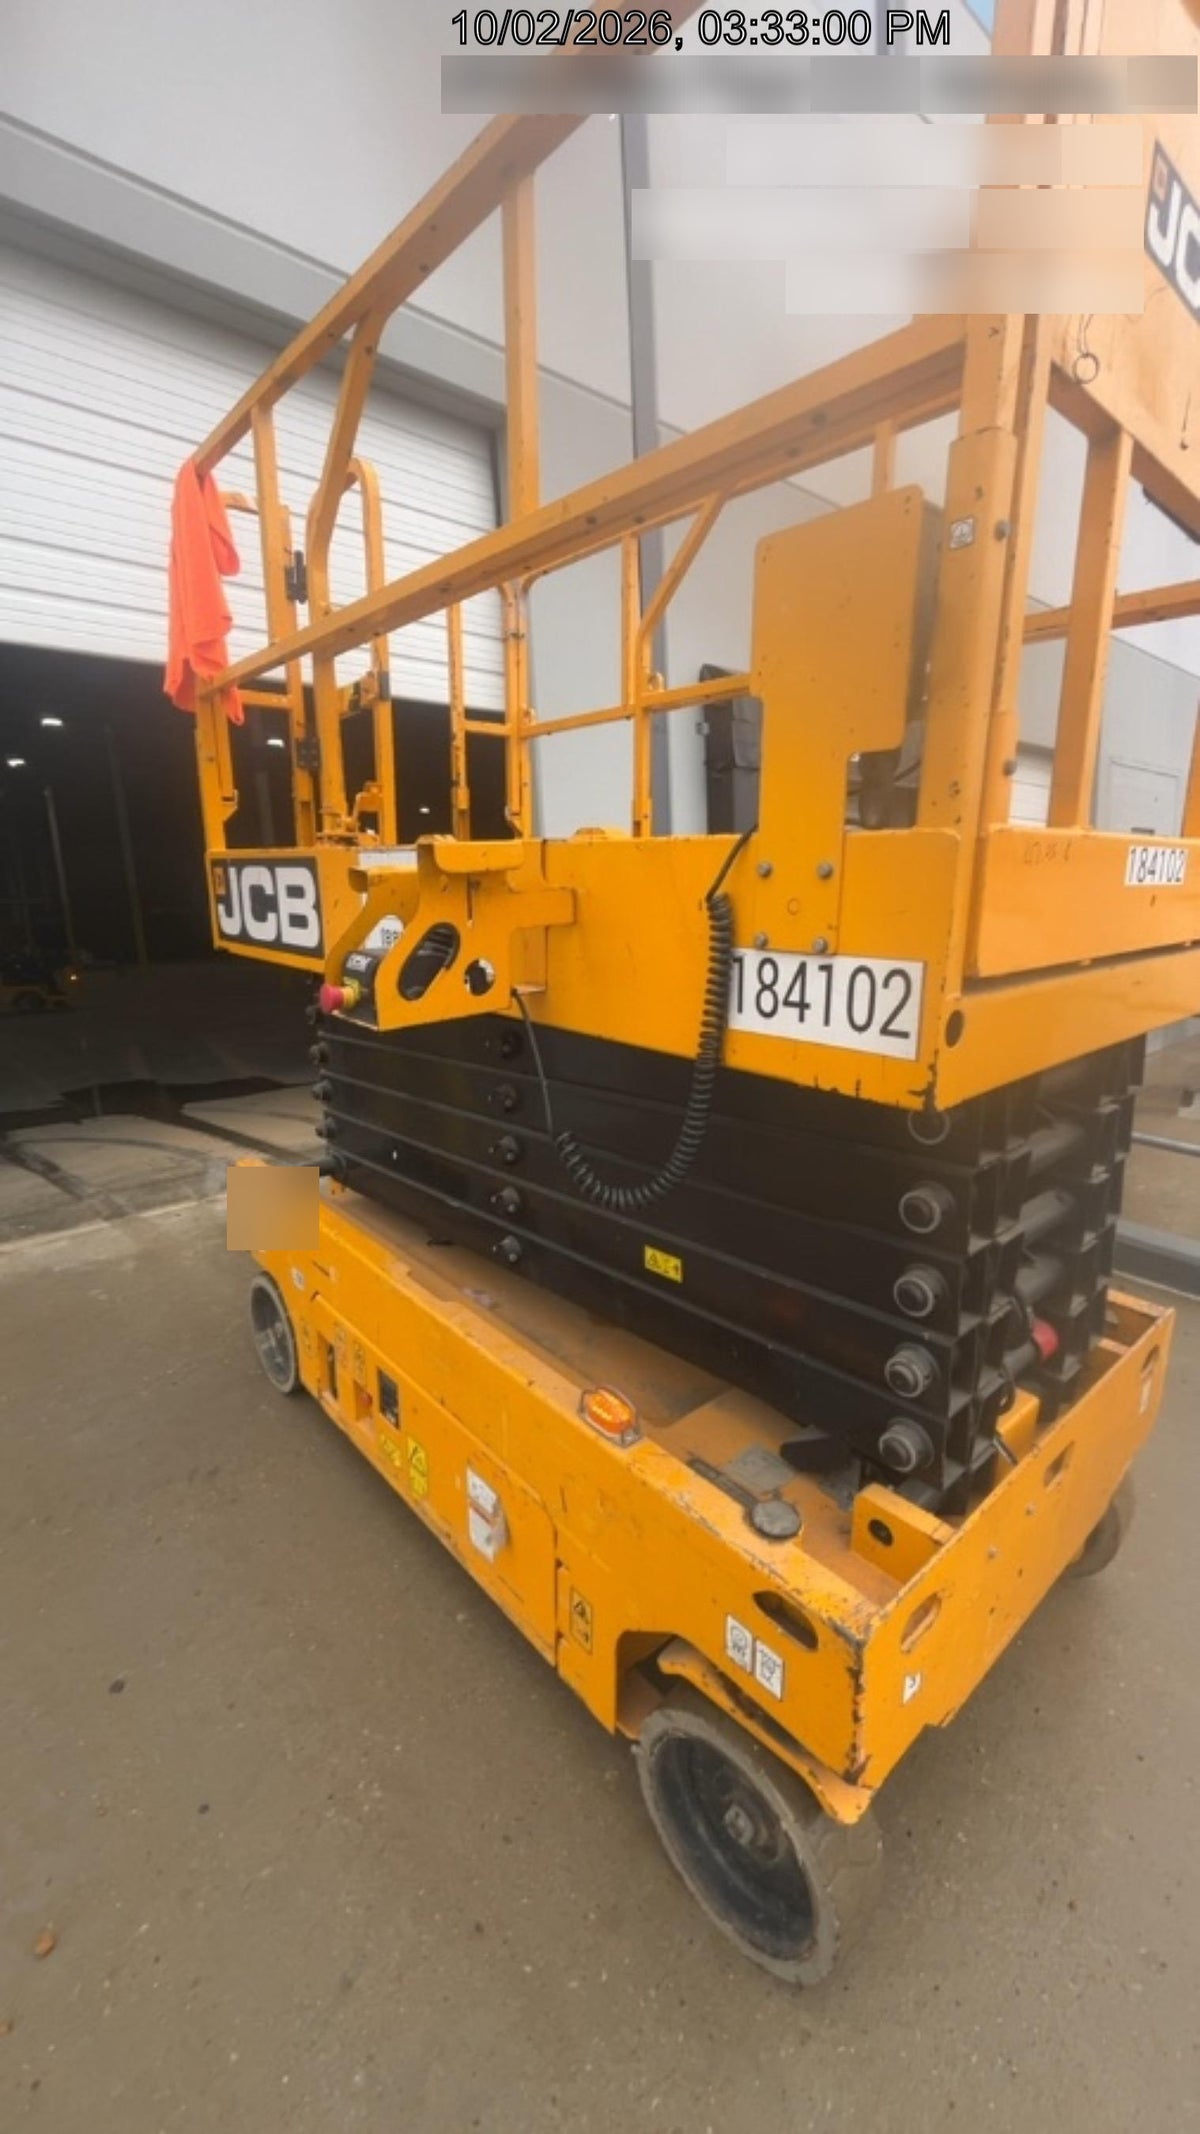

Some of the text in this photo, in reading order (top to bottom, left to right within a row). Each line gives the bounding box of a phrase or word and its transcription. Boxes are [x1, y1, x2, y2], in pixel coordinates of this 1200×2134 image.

[218, 865, 320, 948] JCB
[1128, 848, 1185, 883] 184102
[731, 955, 912, 1039] 184102
